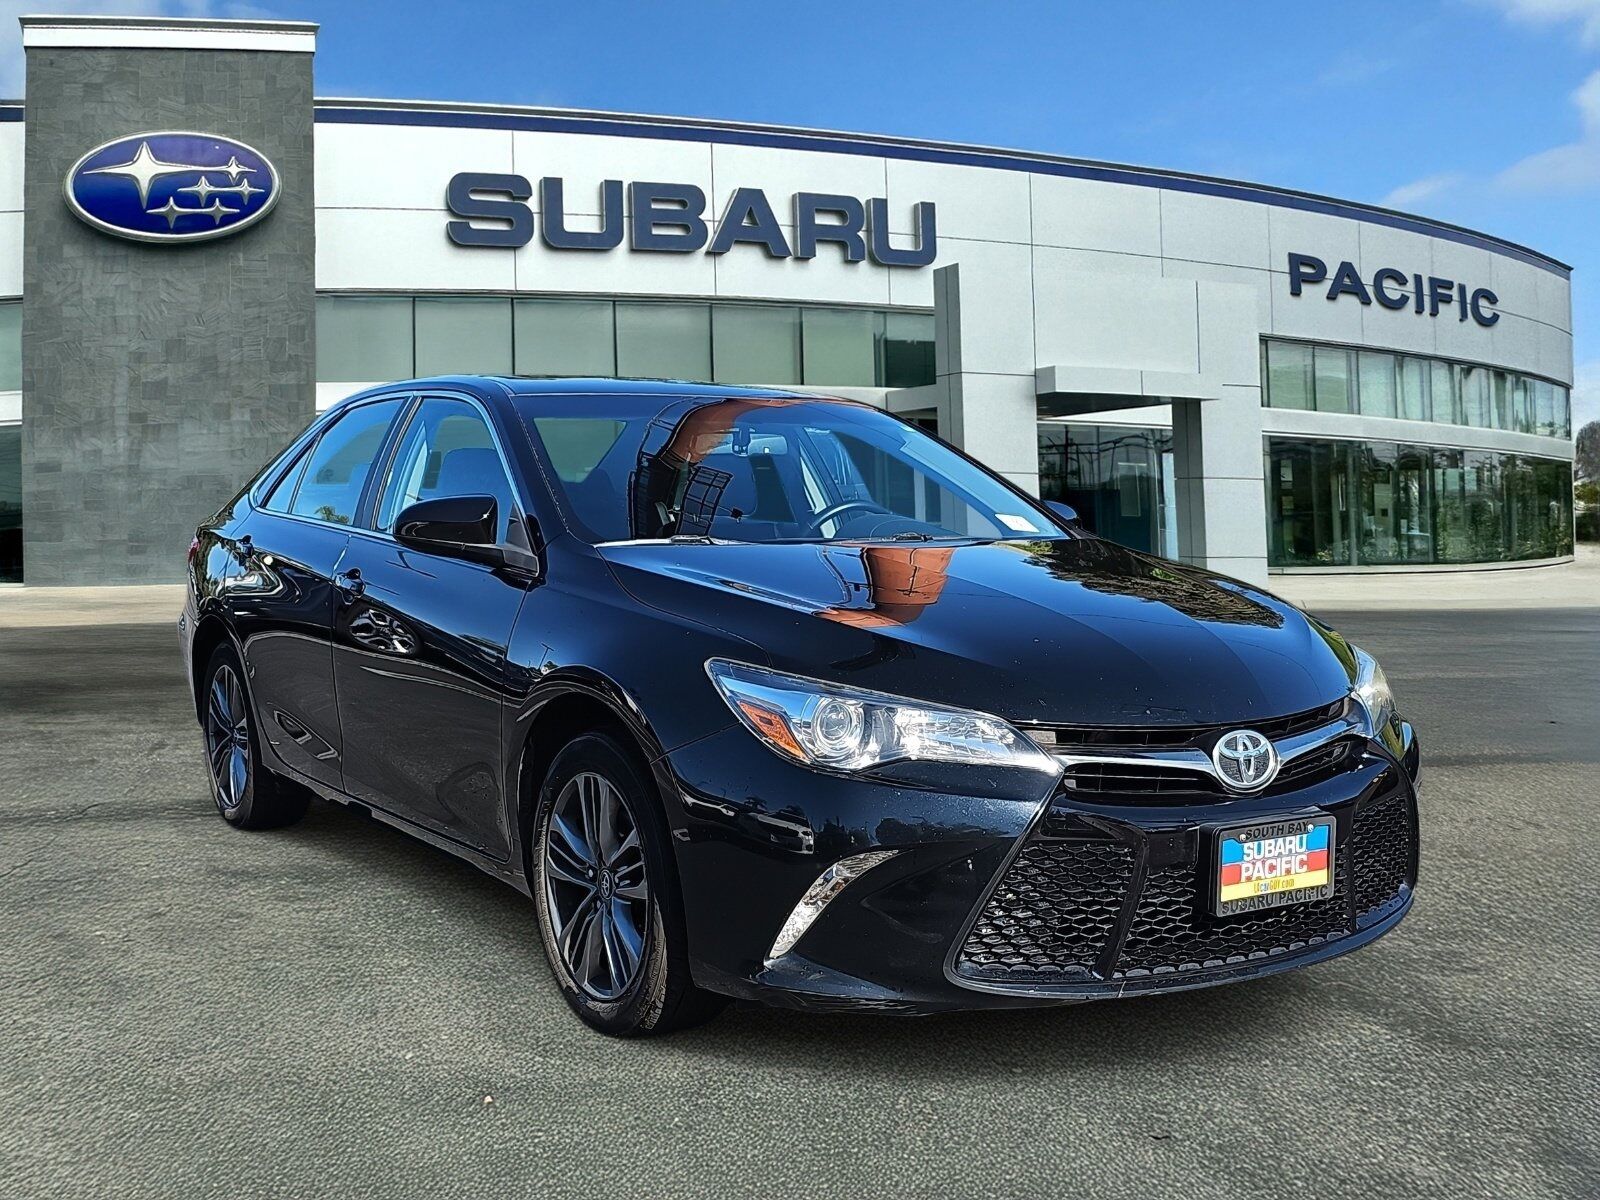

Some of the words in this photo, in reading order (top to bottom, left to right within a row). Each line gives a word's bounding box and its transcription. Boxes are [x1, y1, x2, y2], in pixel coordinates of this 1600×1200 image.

[447, 172, 937, 267] SUBARU
[1288, 252, 1500, 327] PACIFIC
[1245, 824, 1284, 838] SOUTH
[1288, 821, 1308, 833] BAY
[1243, 833, 1307, 861] SUBARU
[1240, 854, 1308, 883] PACIFIC
[1221, 892, 1274, 915] SUBARU
[1280, 885, 1328, 905] PACIFIC
